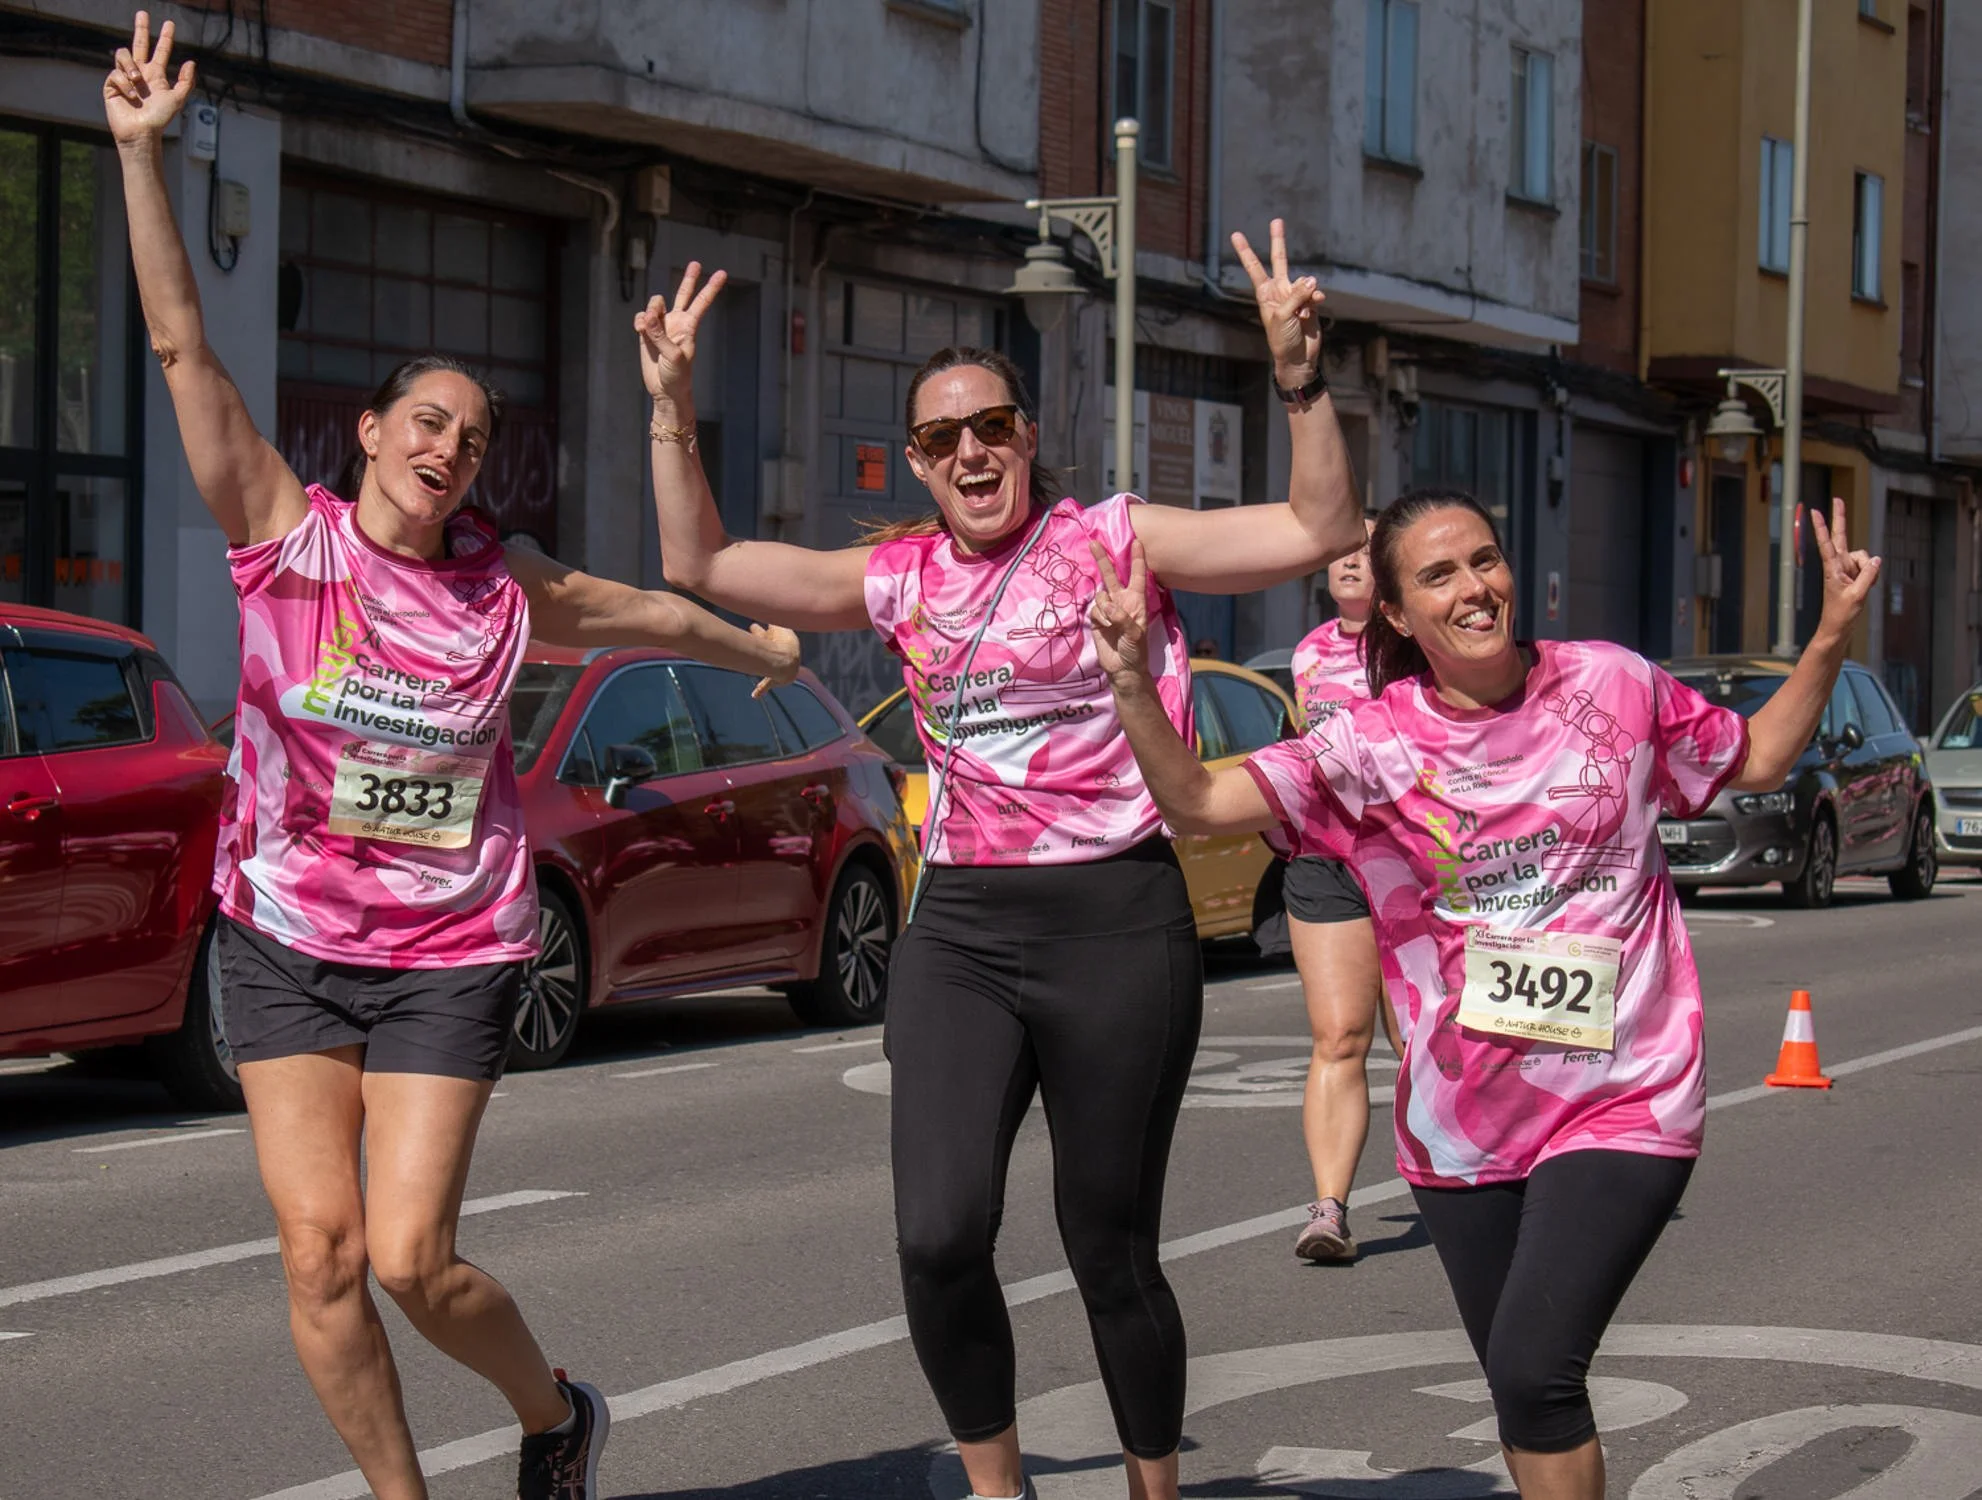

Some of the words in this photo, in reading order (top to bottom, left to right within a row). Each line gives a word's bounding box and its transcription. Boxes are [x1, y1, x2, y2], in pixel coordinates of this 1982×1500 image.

[360, 625, 381, 651] XI
[928, 646, 950, 667] XI
[354, 653, 447, 694] Carrera
[926, 666, 1014, 693] Carrera
[341, 677, 390, 706] por
[393, 690, 416, 711] la
[973, 696, 998, 714] la
[1305, 700, 1344, 713] Carrer
[333, 702, 497, 746] investigación
[355, 773, 454, 820] 3833
[1454, 810, 1478, 833] XI
[1964, 820, 1982, 833] 76
[1071, 834, 1106, 848] Ferrer
[1458, 828, 1560, 863] Carrera
[420, 870, 452, 886] Ferrer
[1465, 869, 1507, 891] por
[1512, 861, 1540, 881] la
[1474, 940, 1521, 949] investigación
[1485, 931, 1512, 942] Carrera
[1488, 960, 1594, 1014] 3492
[1562, 1050, 1600, 1065] Ferrer
